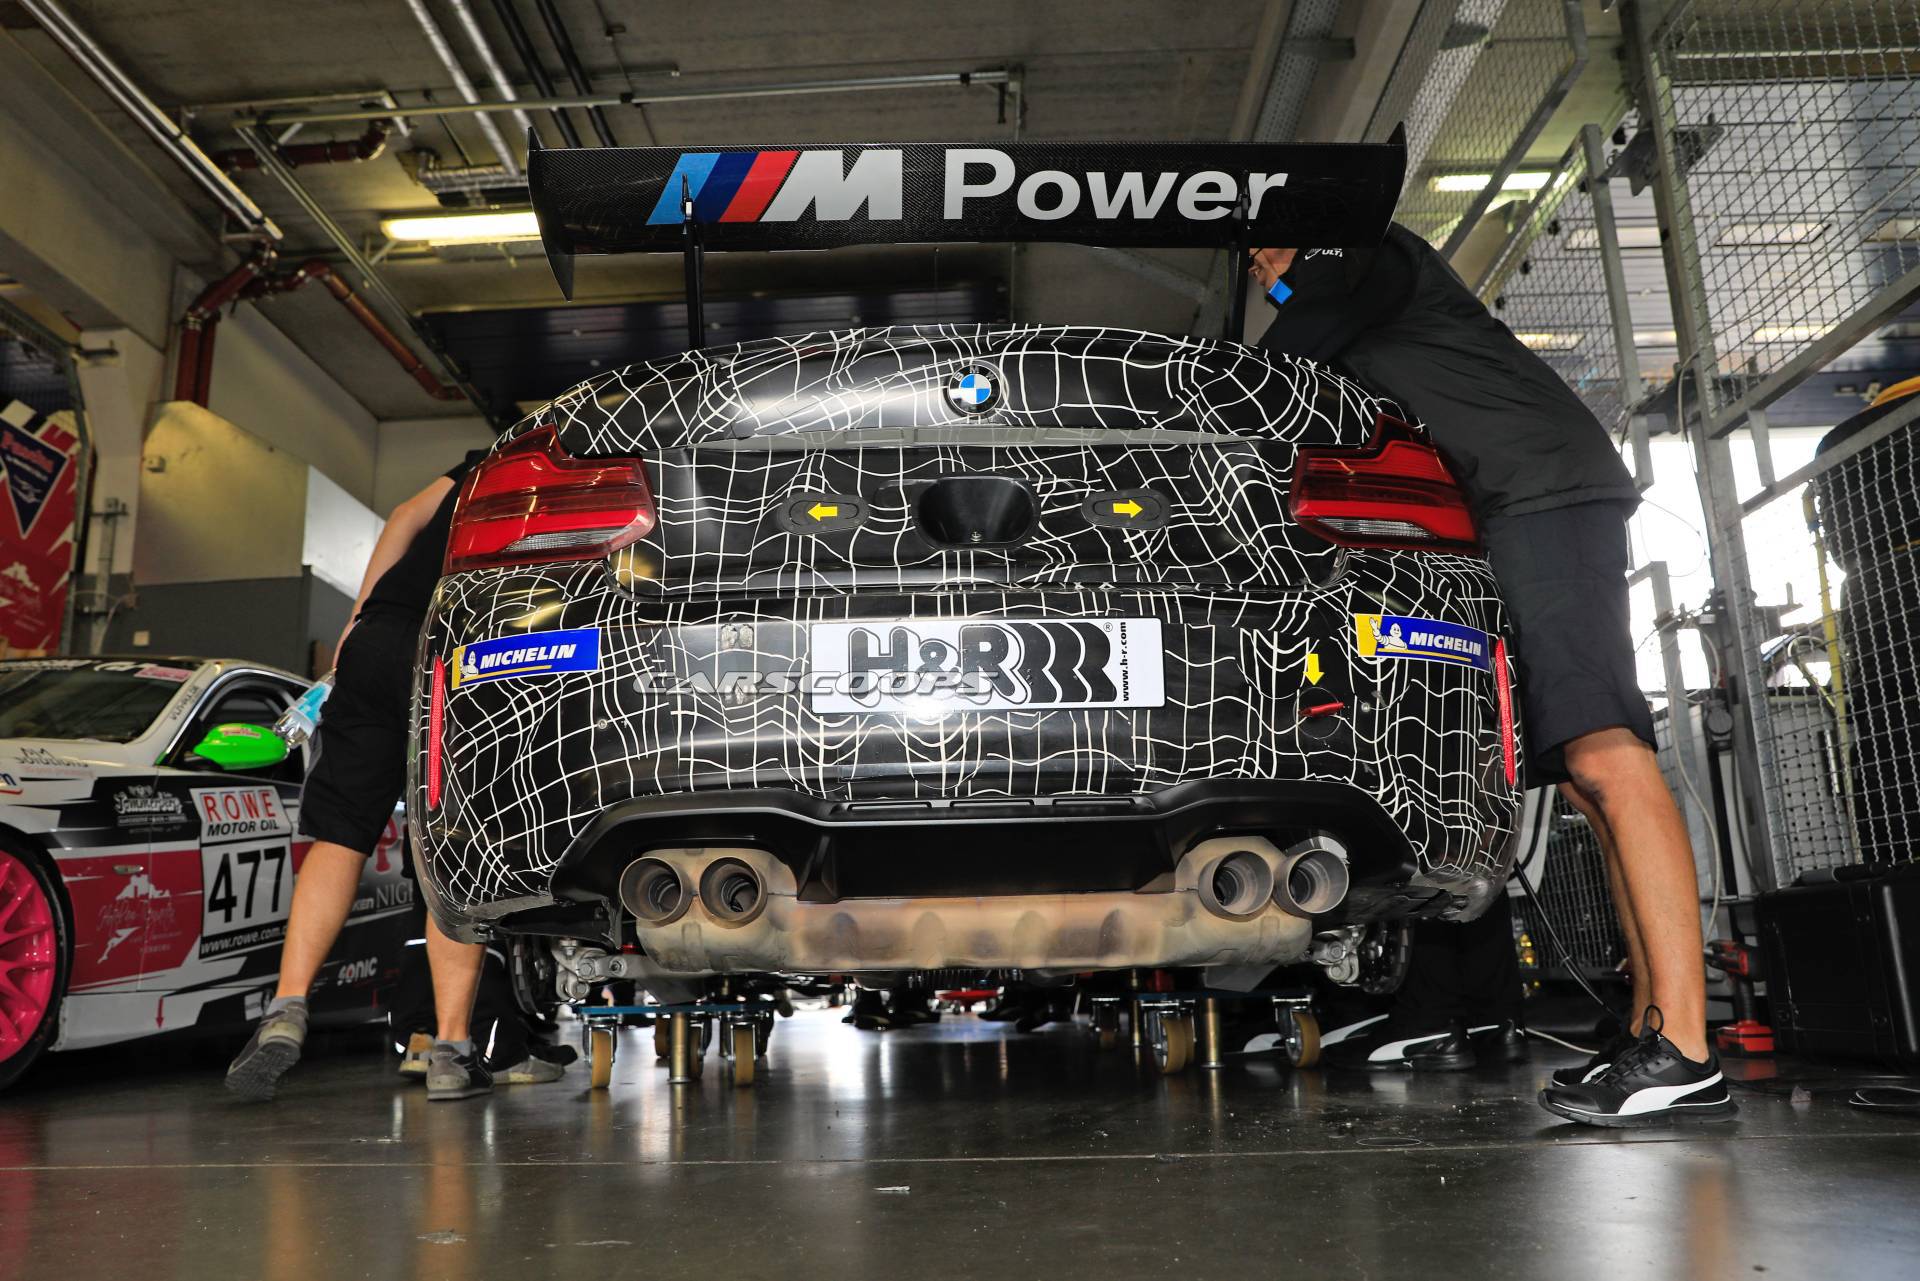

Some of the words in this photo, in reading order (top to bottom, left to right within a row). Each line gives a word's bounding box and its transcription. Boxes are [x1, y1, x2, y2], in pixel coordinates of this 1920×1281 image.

[759, 150, 903, 221] M
[943, 148, 1289, 221] Power
[953, 364, 997, 382] BMW
[480, 643, 577, 670] MICHELIN
[1409, 631, 1482, 657] MICHELIN
[1119, 622, 1129, 702] www.h-r.com
[203, 791, 277, 823] ROWE
[207, 822, 257, 838] MOTOR
[260, 819, 280, 832] OIL
[208, 846, 286, 923] 477
